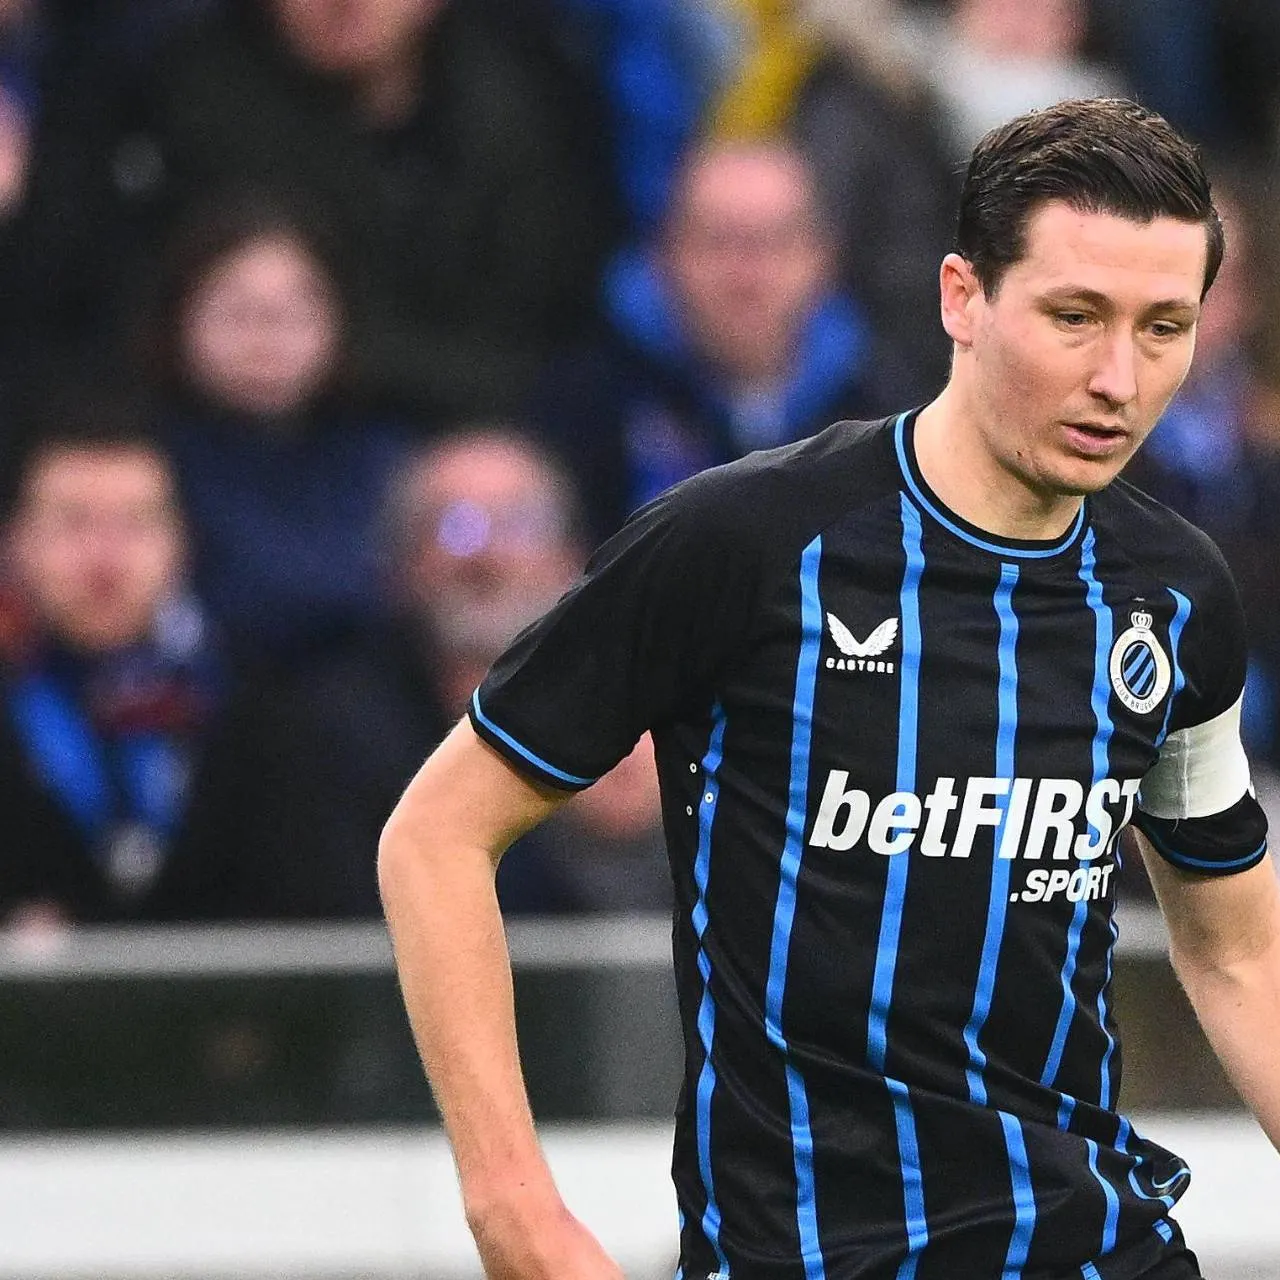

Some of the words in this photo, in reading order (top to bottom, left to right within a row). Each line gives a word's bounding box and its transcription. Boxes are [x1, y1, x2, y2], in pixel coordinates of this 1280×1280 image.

[825, 657, 894, 673] CASTORE
[808, 769, 1142, 861] betFIRST
[1009, 864, 1115, 902] .SPORT
